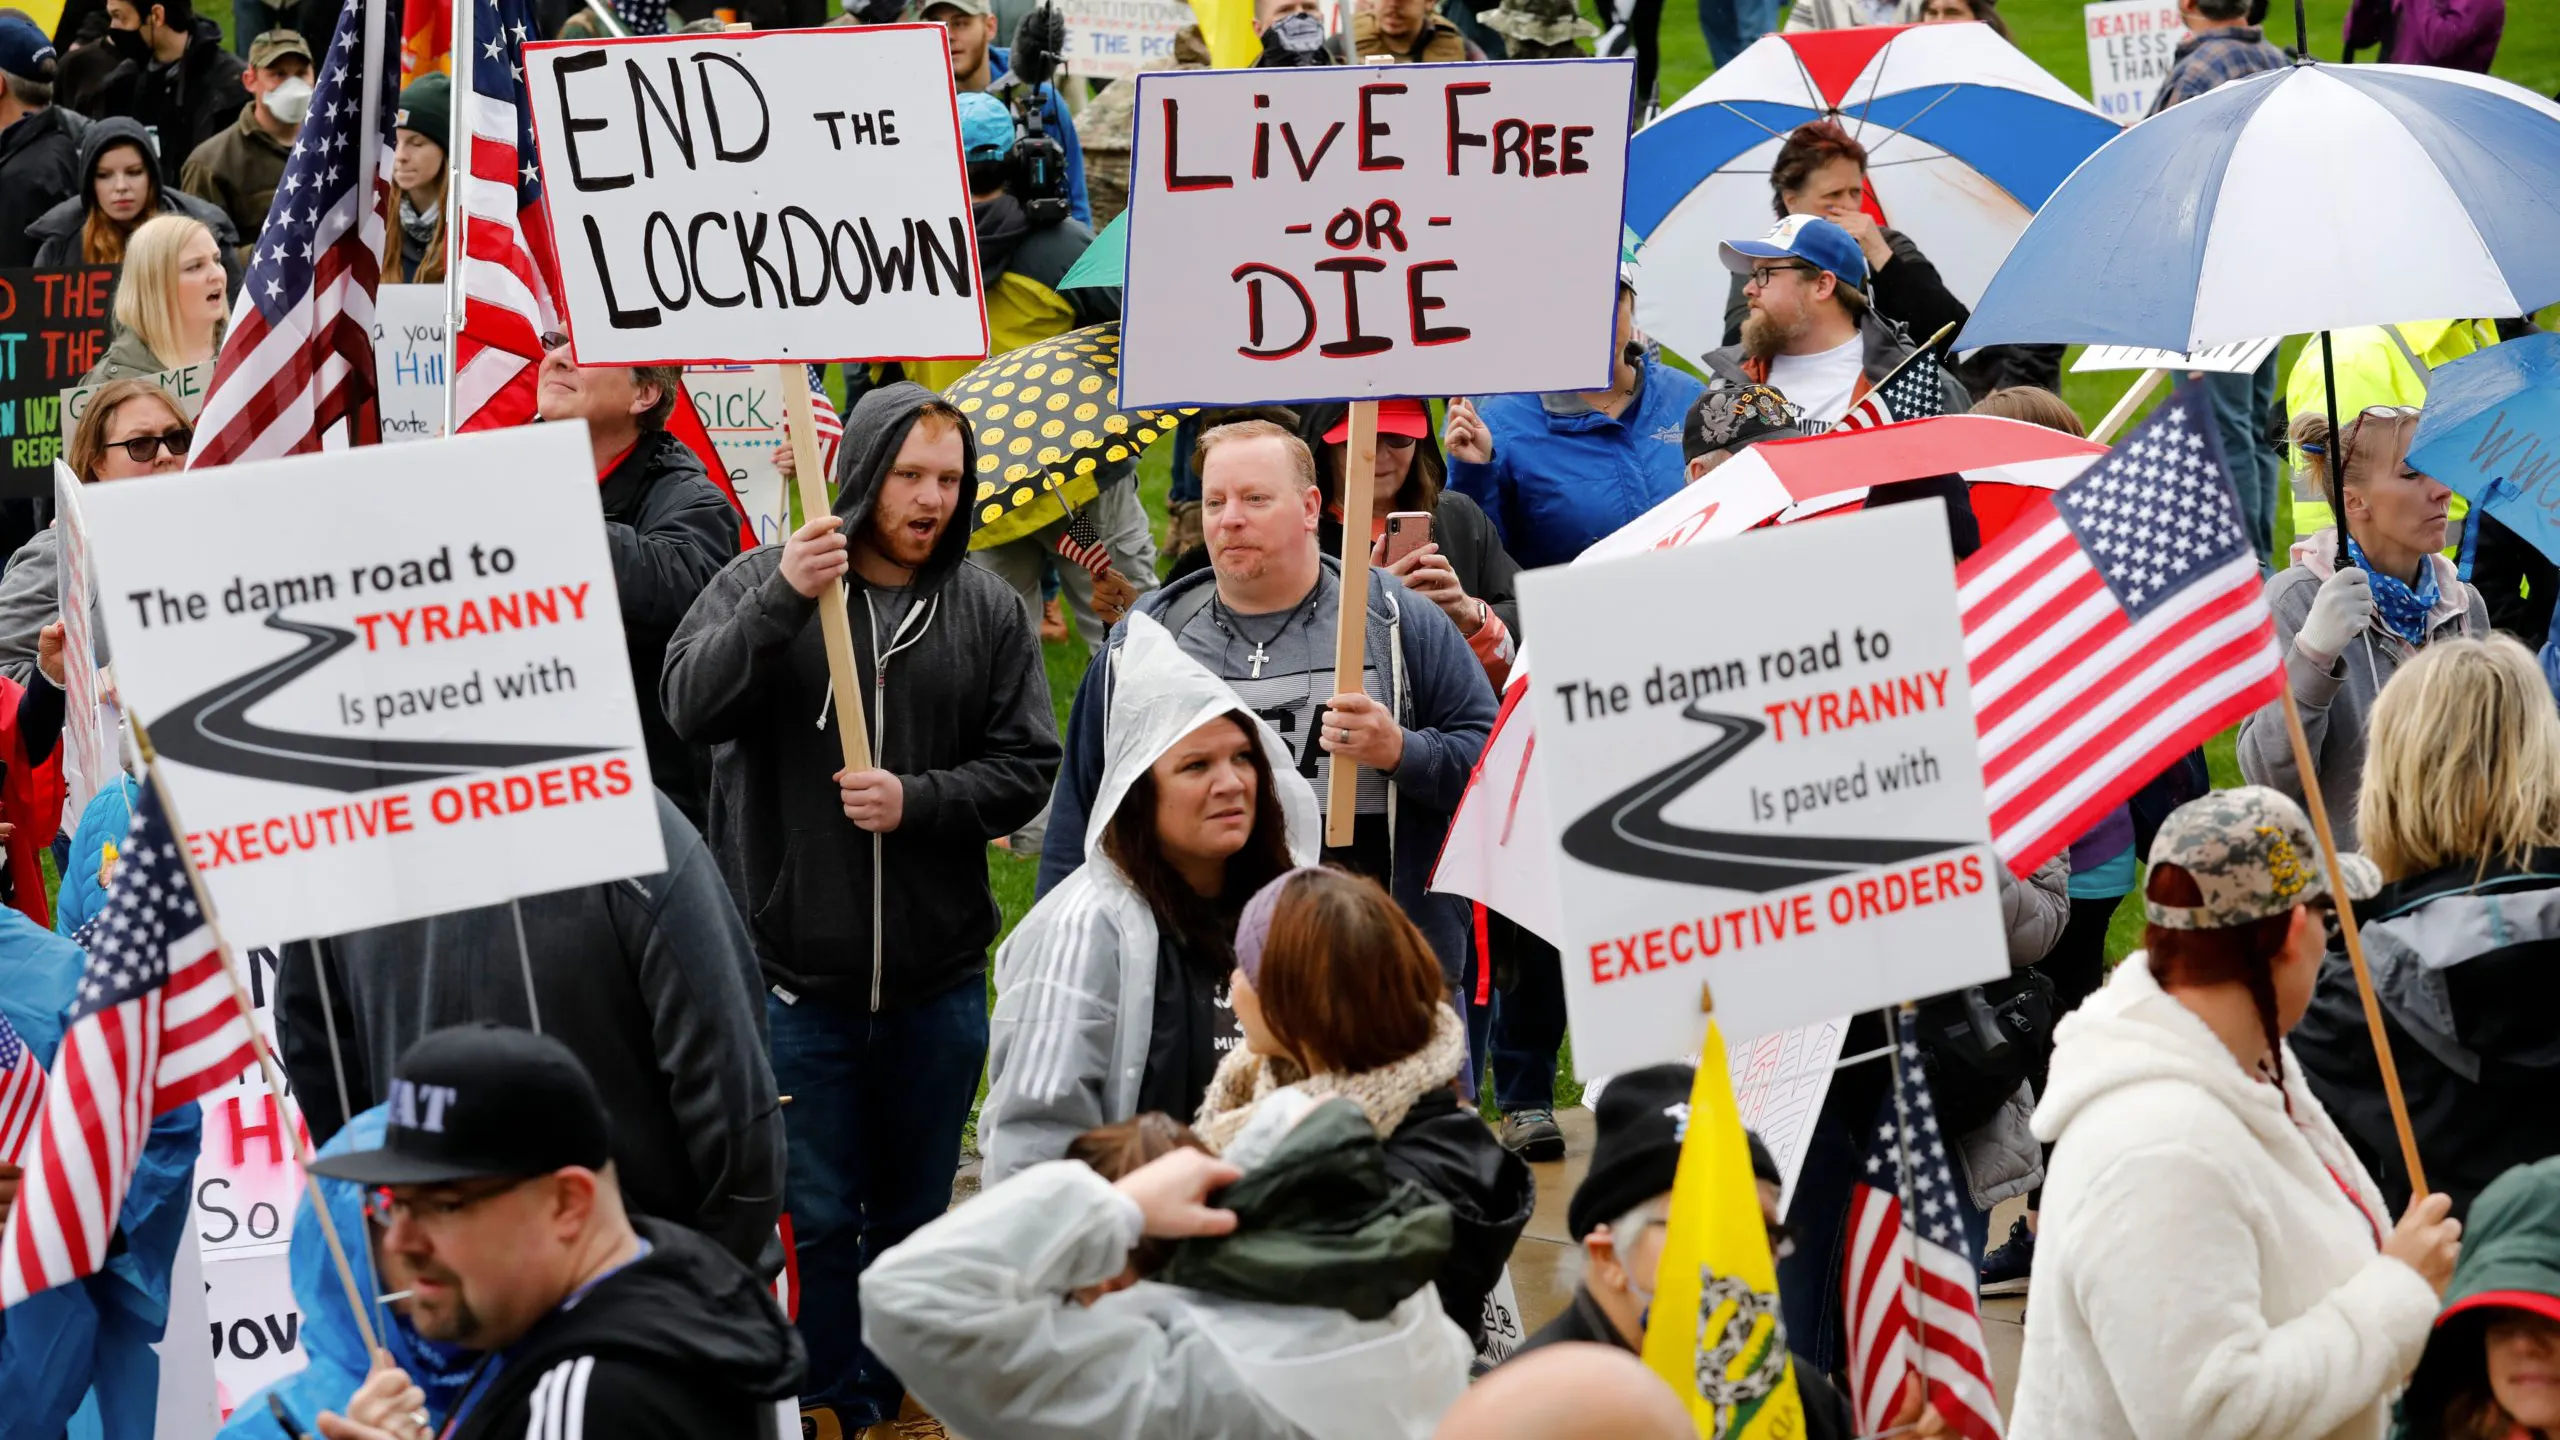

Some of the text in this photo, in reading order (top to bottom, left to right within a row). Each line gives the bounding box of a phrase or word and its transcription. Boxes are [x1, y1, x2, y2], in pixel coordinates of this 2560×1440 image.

[1090, 33, 1130, 54] THE
[2107, 33, 2167, 59] LESS
[553, 49, 900, 192] END THE
[1445, 82, 1594, 178] FREE
[2101, 90, 2142, 115] NOT
[33, 271, 112, 318] THE
[583, 205, 971, 329] LOCKDOWN
[1231, 256, 1471, 361] DIE
[40, 330, 104, 380] THE
[128, 543, 516, 629] The damn road to
[354, 582, 592, 653] TYRANNY
[340, 658, 577, 729] Is paved with
[1556, 626, 1891, 724] The damn road to
[1764, 668, 1950, 744] TYRANNY
[185, 758, 634, 872] EXECUTIVE ORDERS
[1750, 748, 1941, 824] Is paved with
[1588, 854, 1985, 985] EXECUTIVE ORDERS
